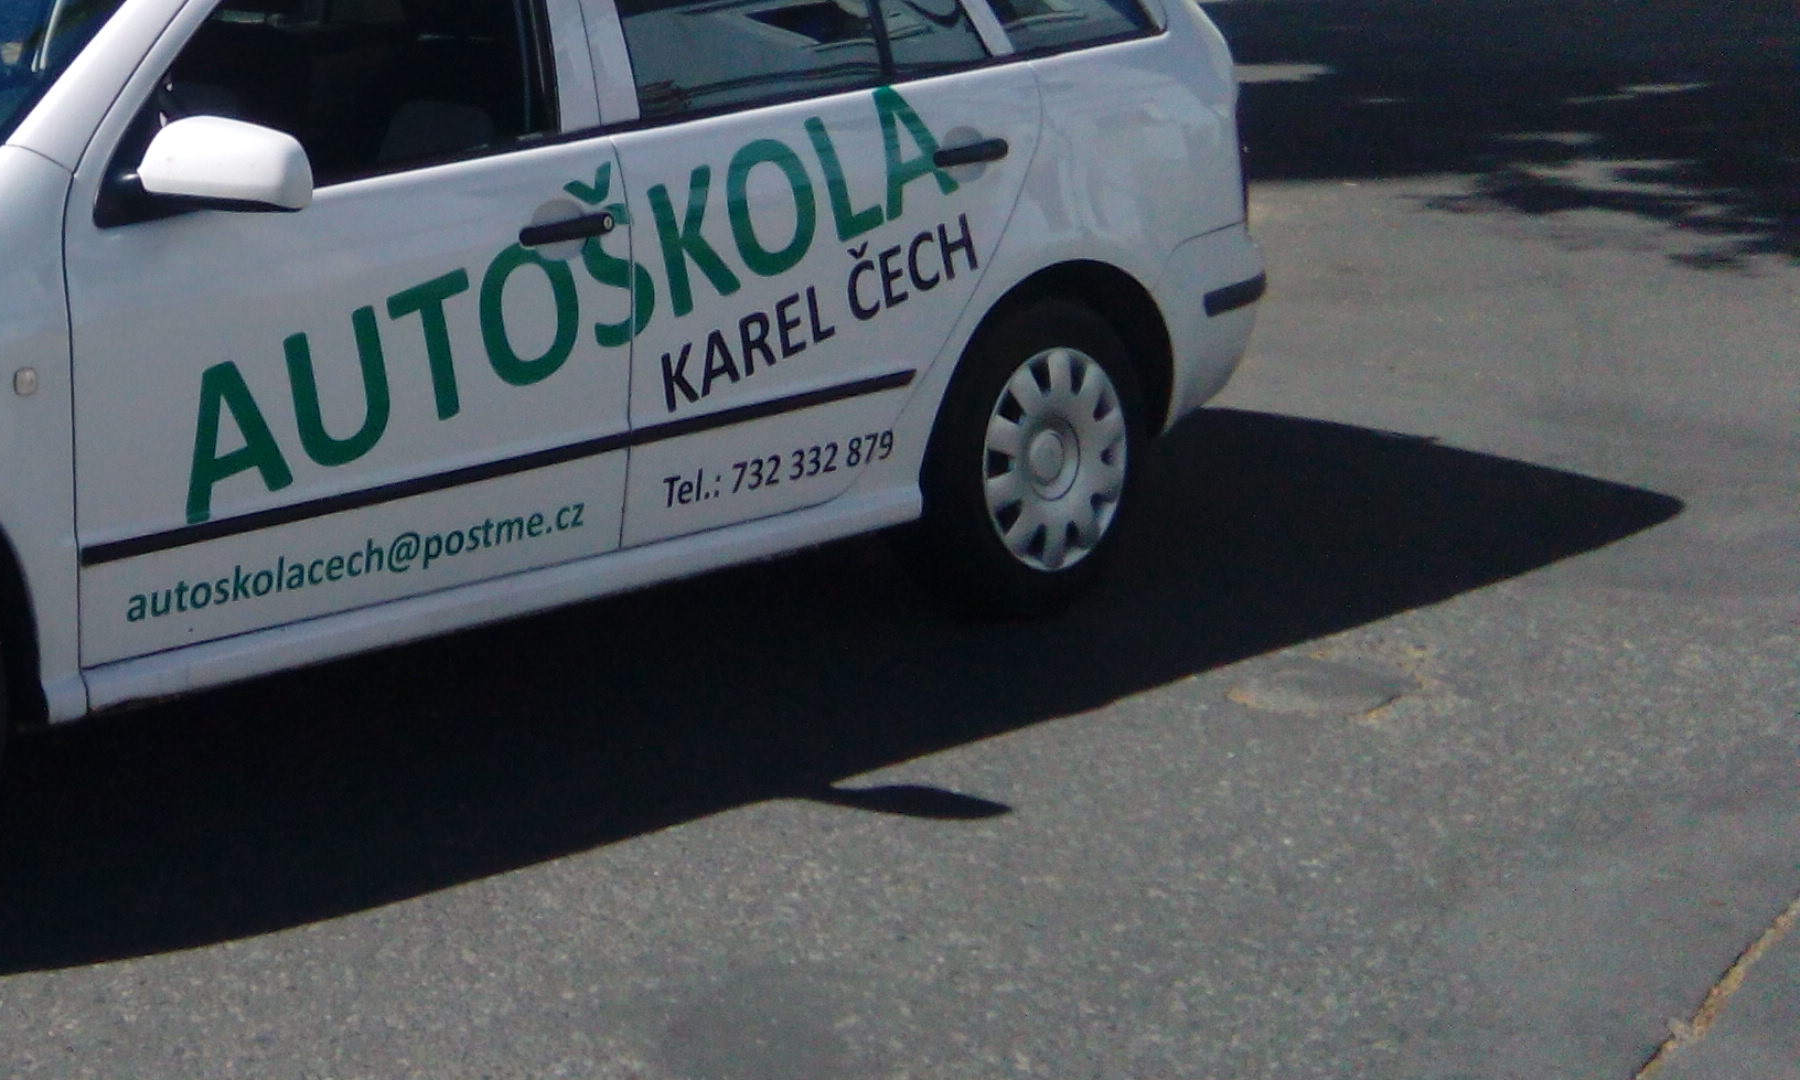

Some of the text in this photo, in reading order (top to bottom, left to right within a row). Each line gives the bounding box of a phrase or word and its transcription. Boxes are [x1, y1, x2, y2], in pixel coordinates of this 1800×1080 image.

[185, 84, 962, 525] AUTOŠKOLA
[660, 212, 979, 413] KAREL ČECH
[662, 428, 896, 510] Tel.: 732 332 879
[124, 497, 587, 624] autoskolacech@postme.cz
